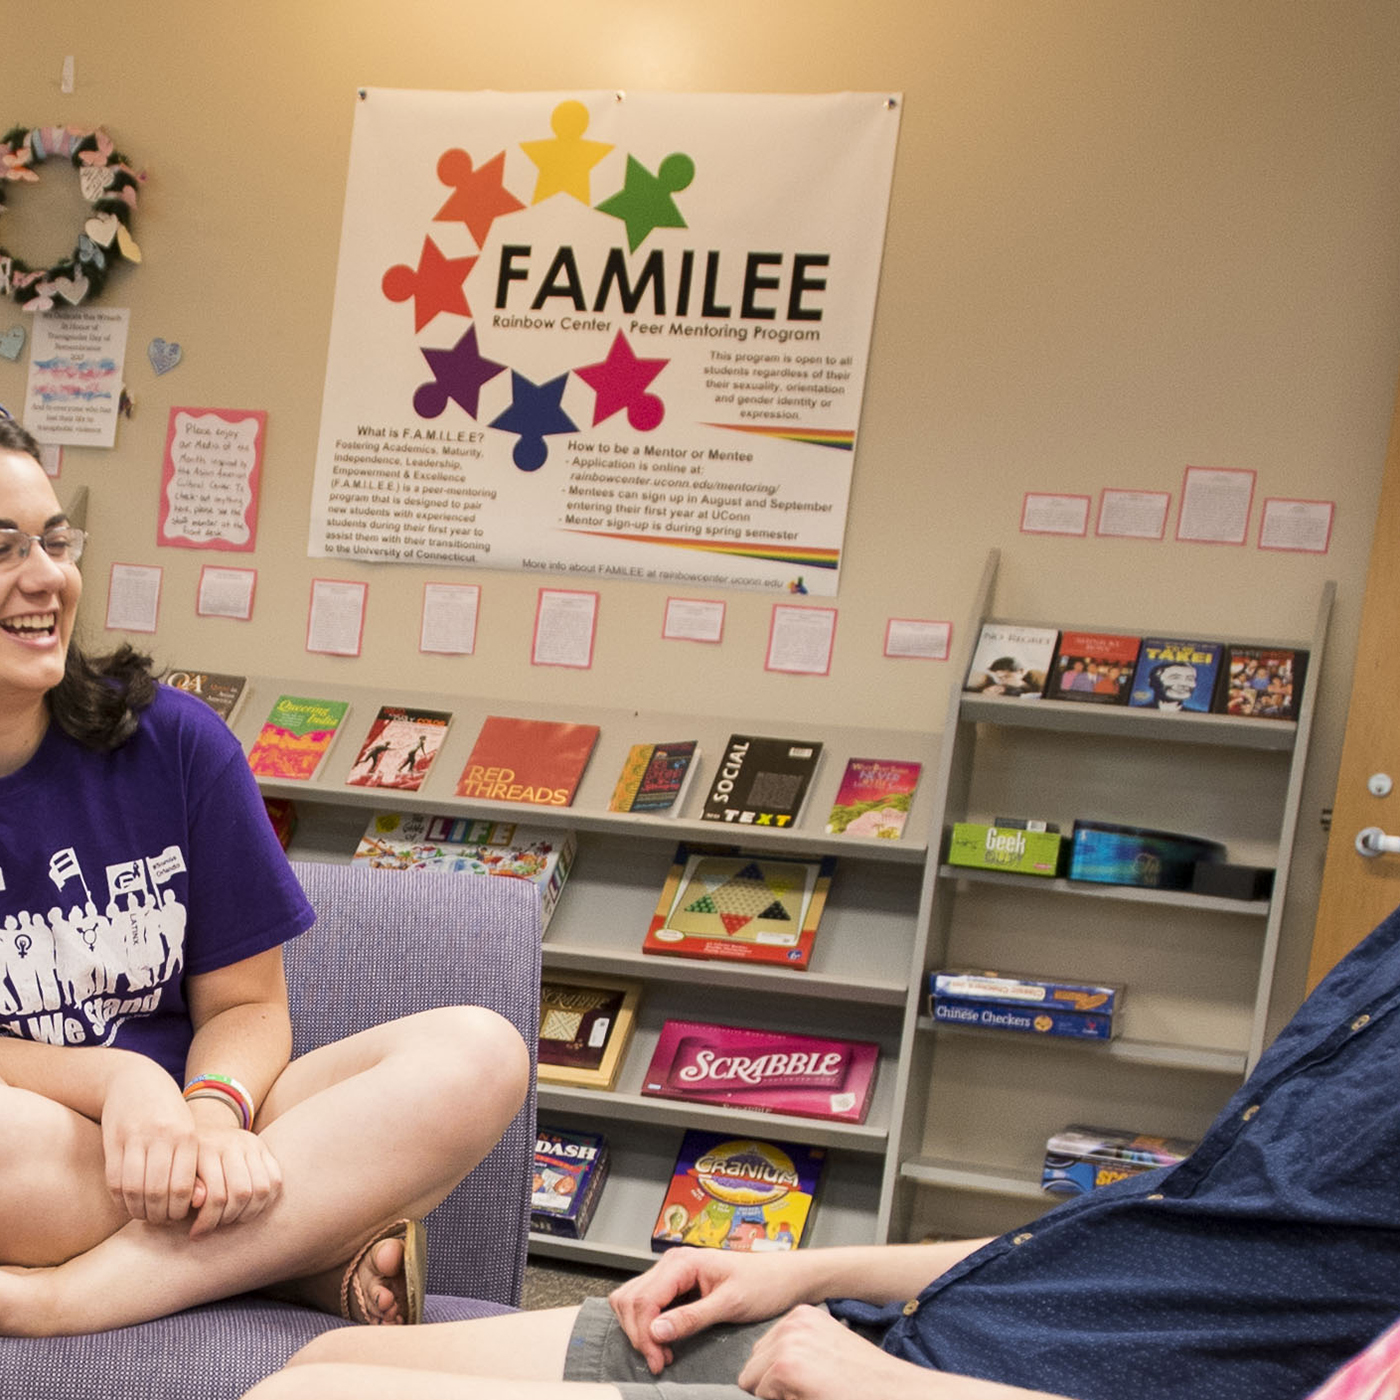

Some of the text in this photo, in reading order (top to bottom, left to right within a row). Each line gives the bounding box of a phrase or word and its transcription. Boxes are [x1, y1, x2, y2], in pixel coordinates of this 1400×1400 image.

[494, 244, 831, 322] FAMILEE
[492, 314, 820, 343] Rainbow Center Peer Mentoring Program
[710, 351, 853, 366] This program is open to all
[704, 366, 850, 380] students regardless of their
[706, 379, 729, 388] their
[786, 384, 845, 394] orientation
[715, 394, 734, 403] and
[737, 396, 774, 406] gender
[777, 396, 816, 408] identity
[186, 423, 240, 439] Please enjoy
[357, 425, 385, 437] What
[389, 427, 398, 438] is
[335, 440, 379, 452] Fostering
[568, 440, 753, 462] How to be a Mentor or Mentee
[333, 466, 466, 482] Empowerment & Excellence
[572, 456, 635, 470] Application
[639, 459, 648, 471] is
[652, 460, 687, 473] online
[403, 484, 410, 492] is
[422, 486, 497, 499] peer-mentoring
[569, 486, 833, 514] Mentees can sign up in August and September
[329, 492, 482, 511] program that is designed to pair
[328, 506, 476, 523] new students with experienced
[567, 501, 751, 522] entering their first year at UConn
[327, 518, 483, 536] students during their first year to
[565, 514, 799, 541] Mentor sign-up is during spring semester
[325, 544, 334, 552] to
[336, 544, 350, 553] the
[353, 545, 401, 558] University
[404, 548, 413, 557] of
[326, 531, 491, 552] assist them with their transitioning
[522, 558, 547, 570] More
[549, 562, 566, 571] info
[568, 563, 596, 573] about
[598, 564, 644, 577] FAMILEE
[647, 568, 656, 578] at
[1146, 648, 1213, 664] TAKEI
[468, 765, 515, 783] RED
[713, 742, 750, 804] SOCIAL
[463, 779, 569, 805] THREADS
[724, 809, 791, 826] TEXT
[426, 816, 517, 846] LIFE
[985, 827, 1026, 855] Geek
[130, 913, 139, 945] LATINX
[936, 1006, 1031, 1027] Chinese Checkers
[27, 1012, 86, 1046] We
[680, 1050, 842, 1084] SCRABBLE
